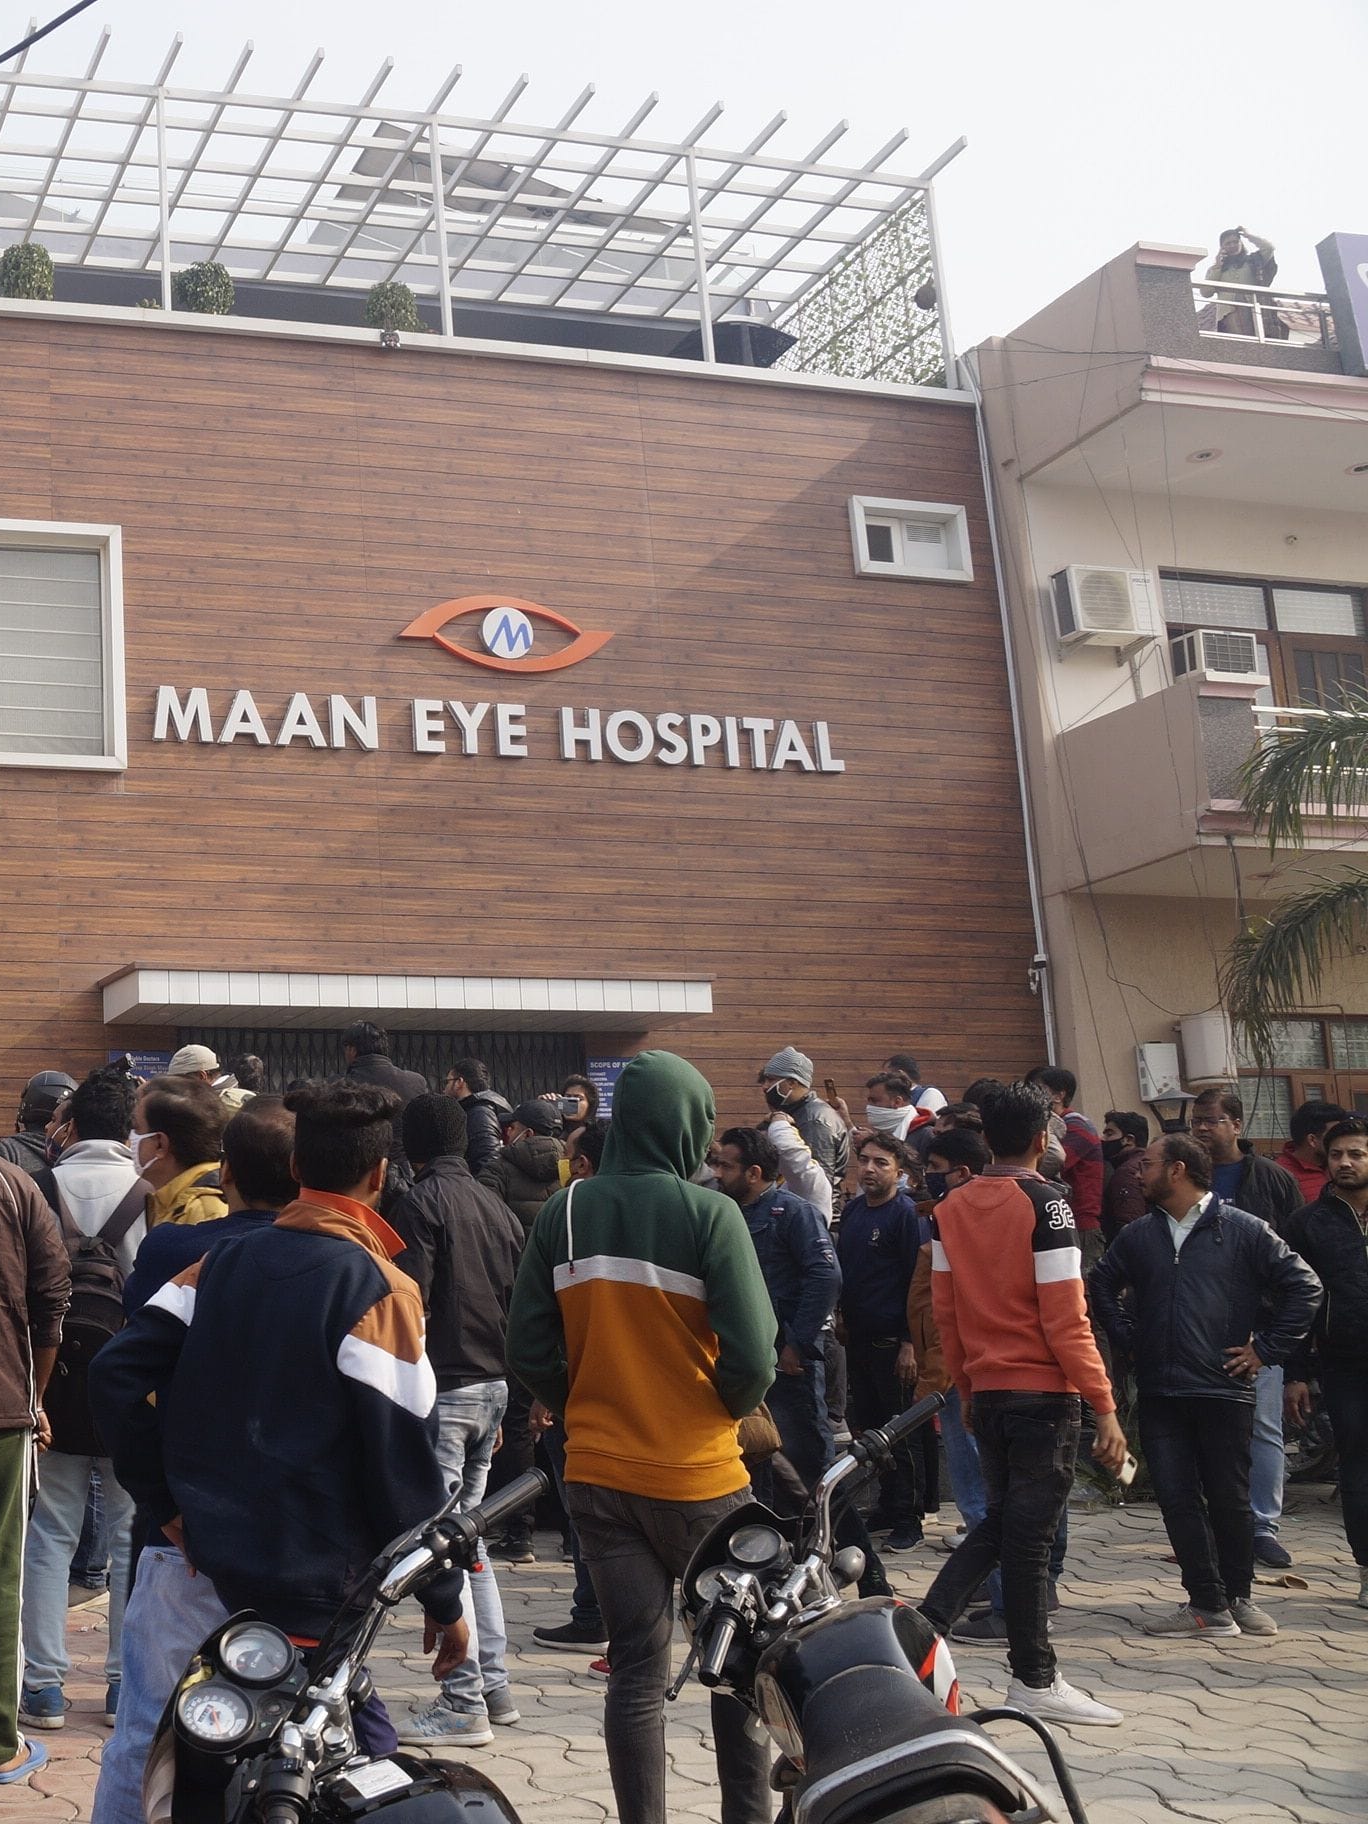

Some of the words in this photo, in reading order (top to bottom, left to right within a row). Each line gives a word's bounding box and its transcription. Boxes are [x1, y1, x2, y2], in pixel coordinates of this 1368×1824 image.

[489, 614, 532, 652] M
[153, 685, 379, 750] MAAN
[411, 698, 528, 758] EYE
[560, 706, 845, 773] HOSPITAL
[1045, 1198, 1076, 1230] 32
